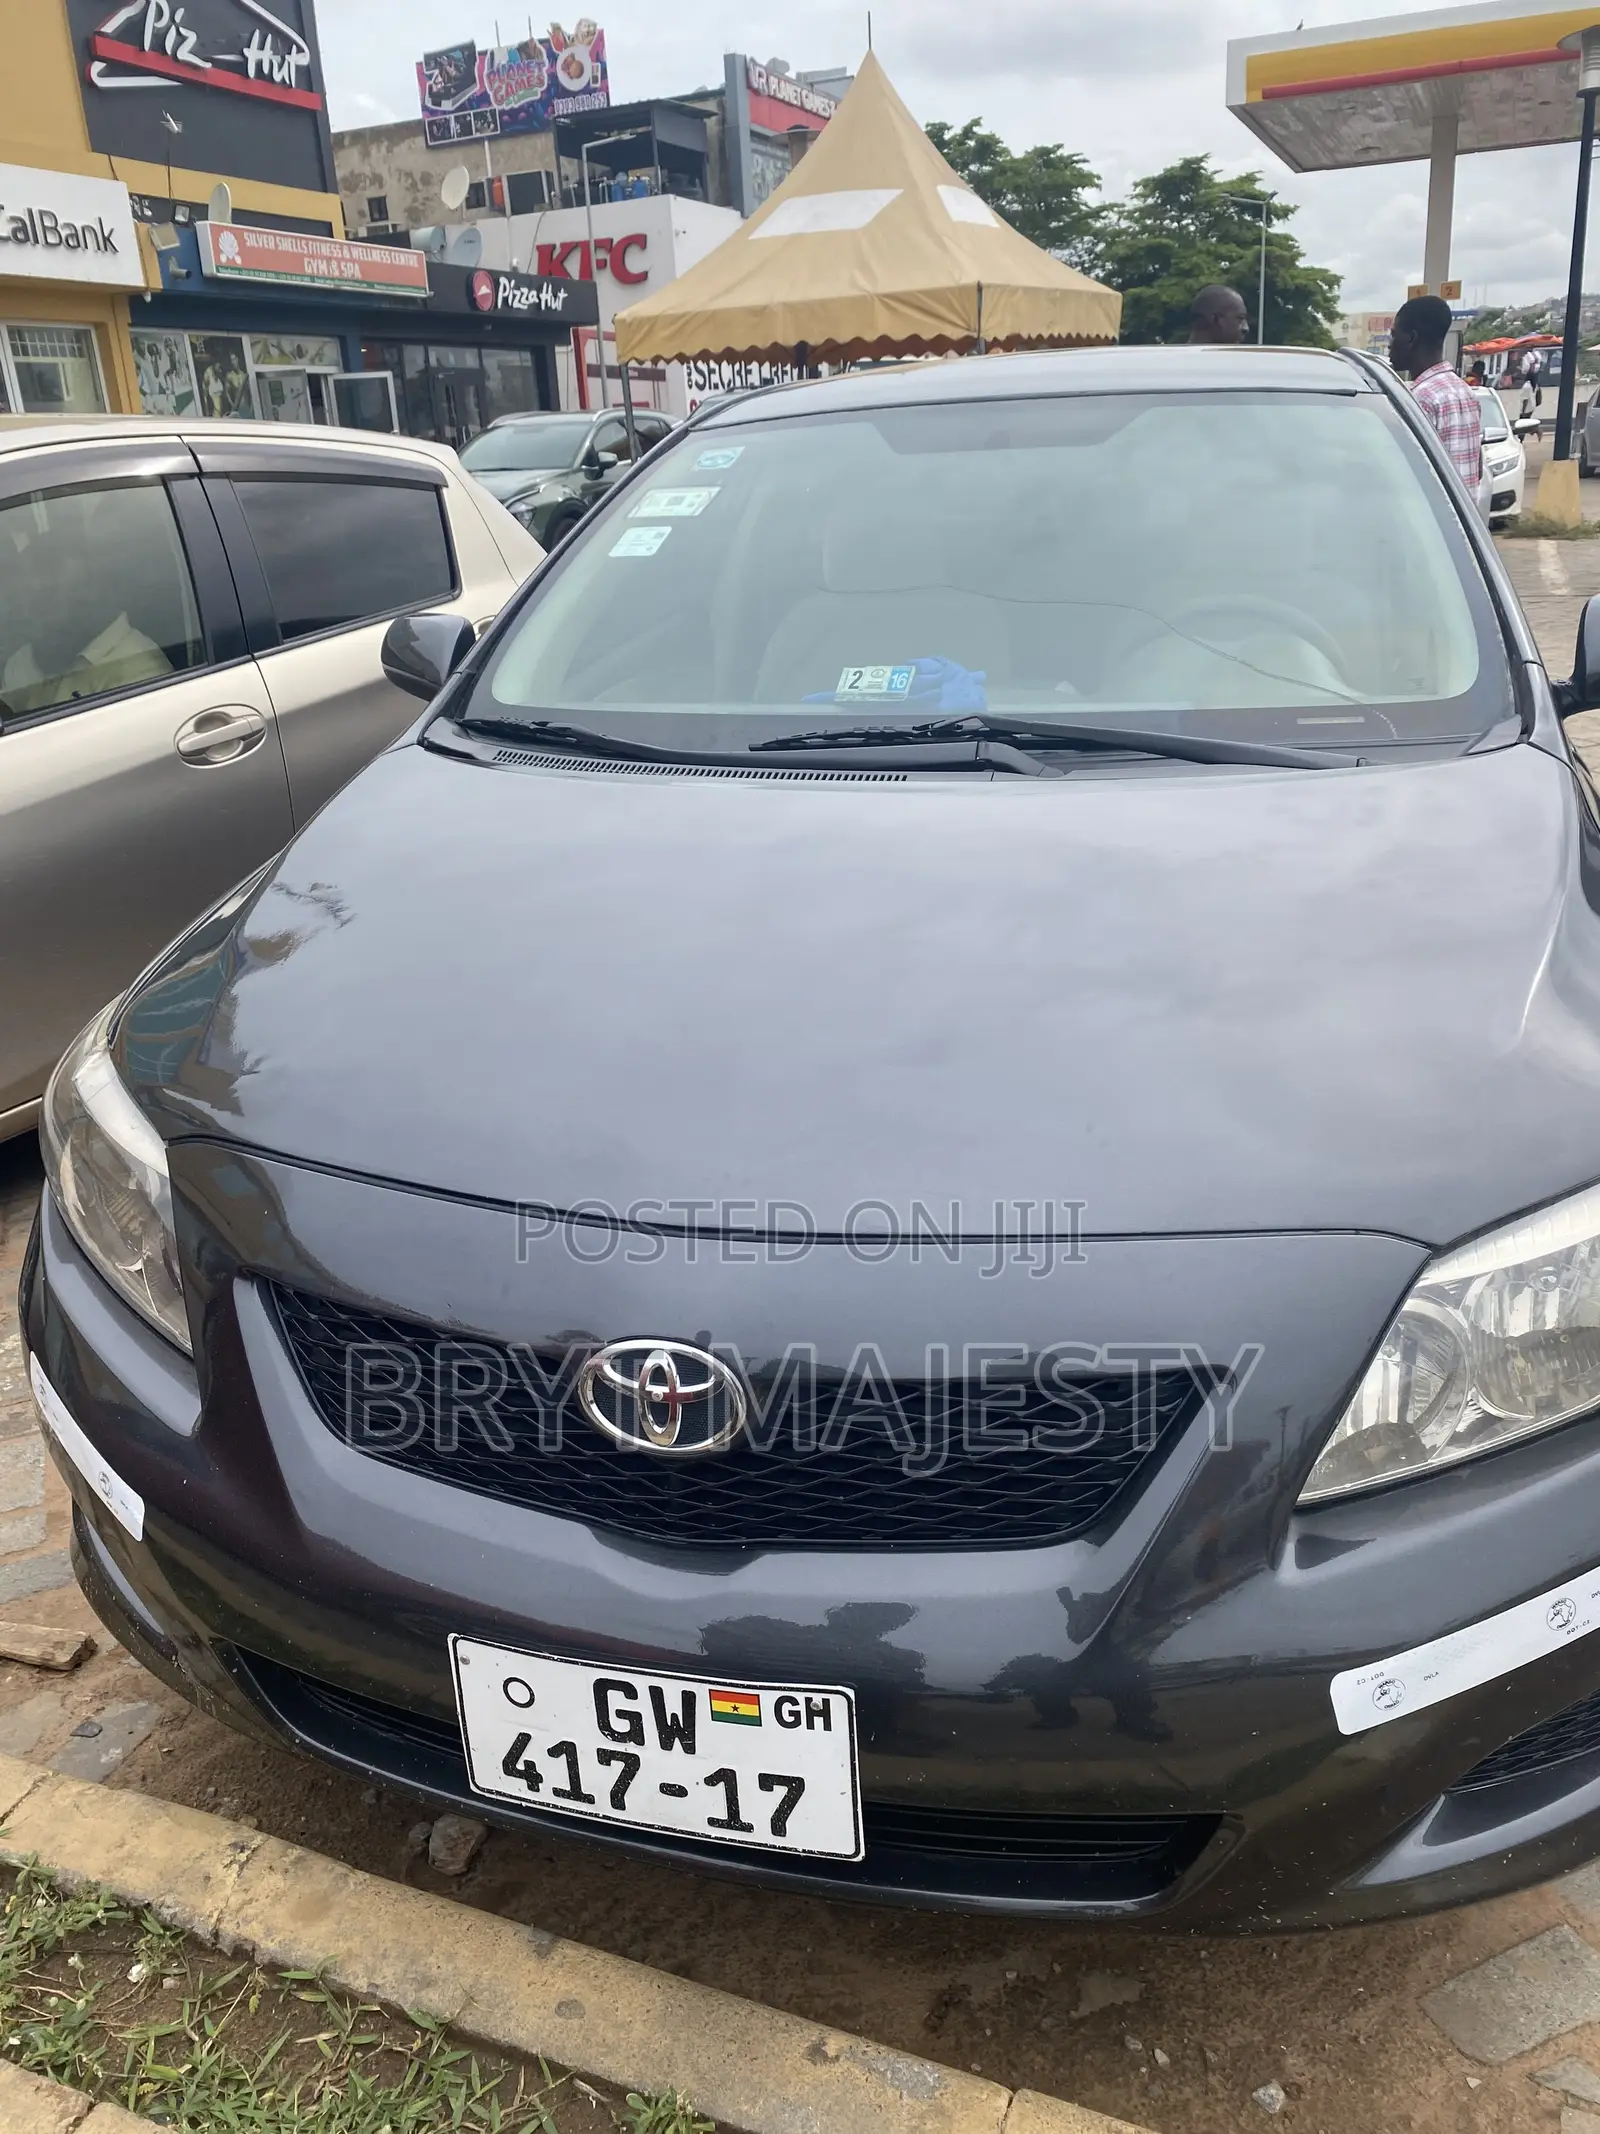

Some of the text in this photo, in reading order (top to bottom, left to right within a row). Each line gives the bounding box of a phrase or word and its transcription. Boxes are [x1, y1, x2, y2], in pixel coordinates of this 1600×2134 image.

[143, 0, 309, 88] Piz Hut
[487, 60, 546, 90] PLANET
[493, 74, 546, 106] GAMES
[769, 74, 801, 106] PLANET
[243, 231, 419, 268] SILVER SHELLS FITNESS & WELLNESS CENTRE
[536, 233, 648, 285] KFC
[304, 258, 328, 276] GYM
[341, 261, 362, 279] SPA
[497, 277, 568, 311] Pizza Hut
[1446, 286, 1454, 296] 2
[848, 670, 863, 689] 2
[892, 672, 909, 689] 16
[593, 1678, 832, 1755] GW GH
[501, 1732, 806, 1837] 417-17
